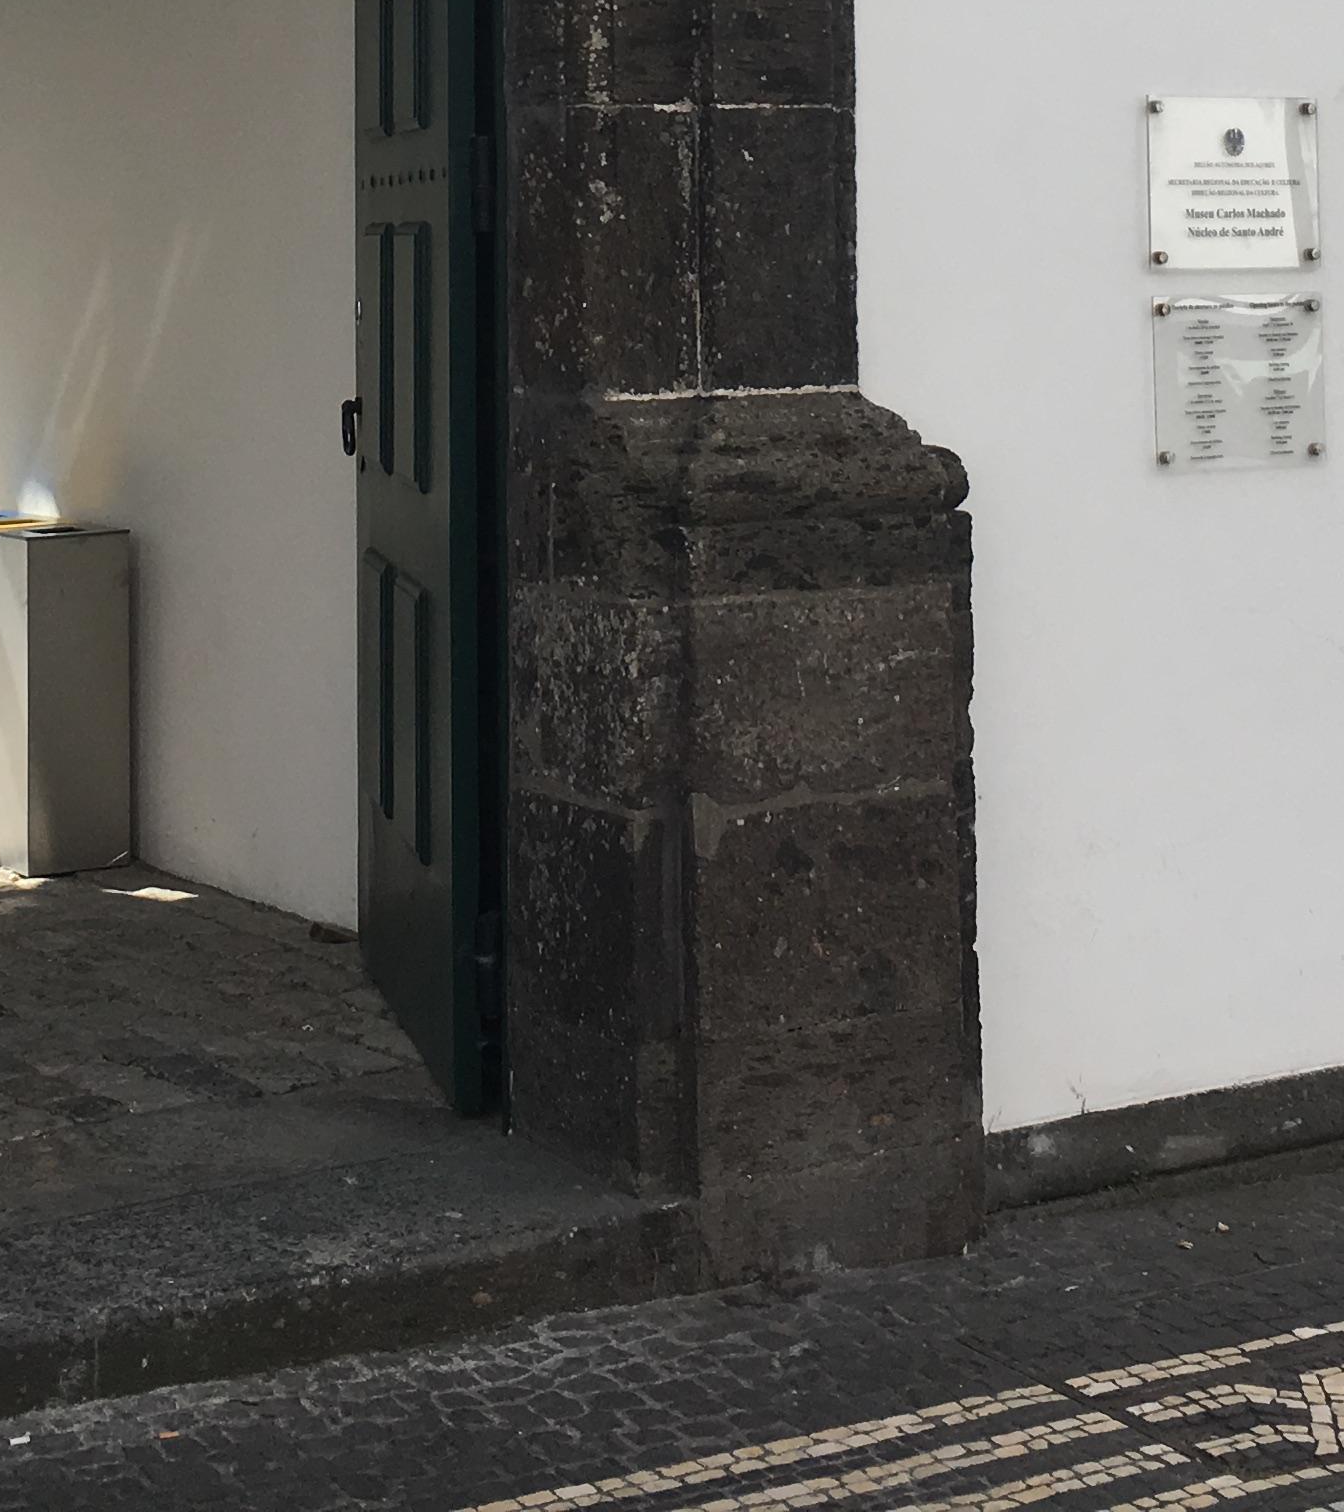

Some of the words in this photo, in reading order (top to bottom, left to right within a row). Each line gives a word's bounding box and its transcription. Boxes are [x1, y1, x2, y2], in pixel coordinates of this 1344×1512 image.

[1185, 208, 1214, 219] Museu
[1216, 208, 1245, 219] Carlos
[1247, 208, 1286, 219] Machado
[1187, 226, 1217, 238] Núcleo
[1219, 227, 1230, 237] de
[1231, 226, 1256, 237] Santo
[1258, 226, 1284, 237] André
